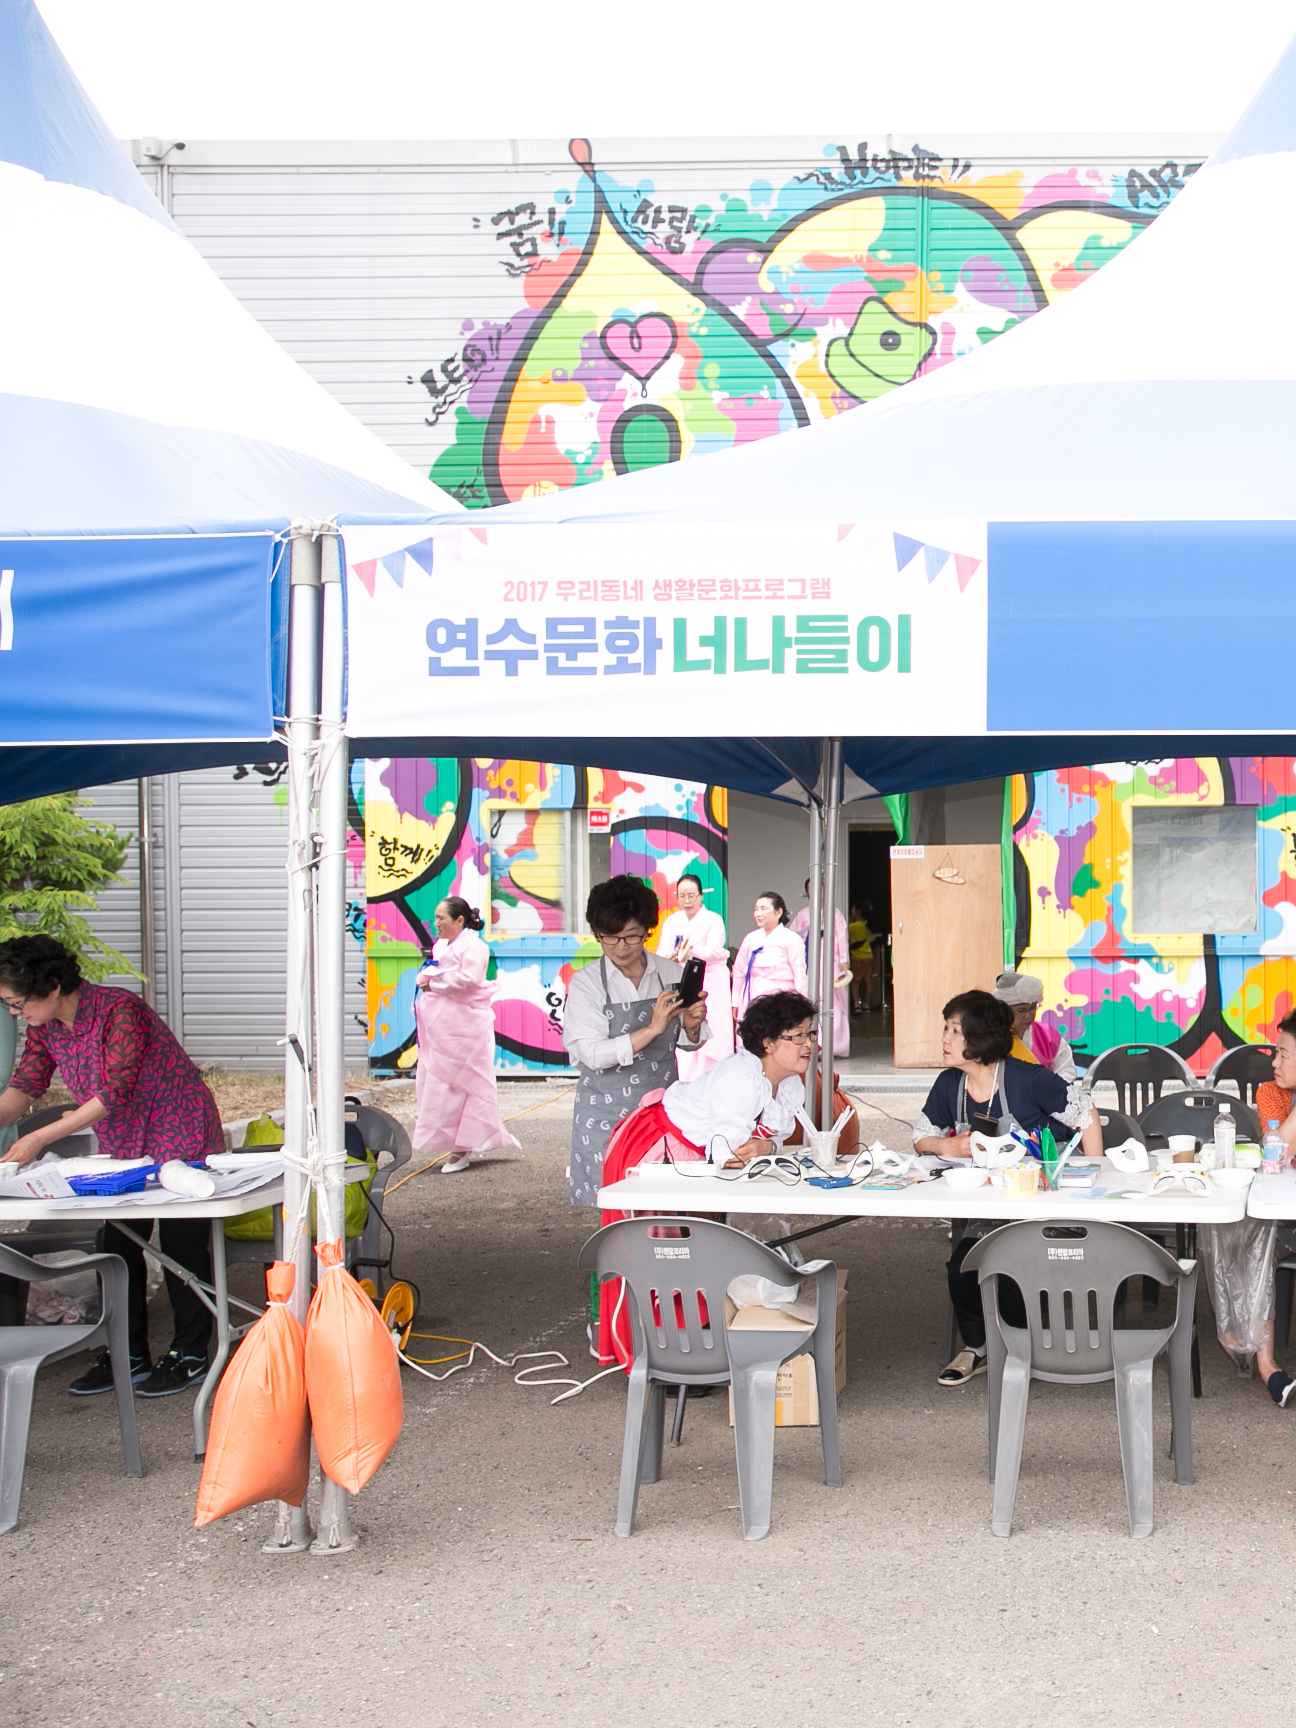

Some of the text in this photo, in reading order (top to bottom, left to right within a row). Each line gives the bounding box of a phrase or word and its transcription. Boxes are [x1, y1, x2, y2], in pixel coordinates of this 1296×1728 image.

[502, 577, 831, 603] 2017 우리동네 생활문화프로그램
[425, 613, 912, 678] 연수문화 너나들이
